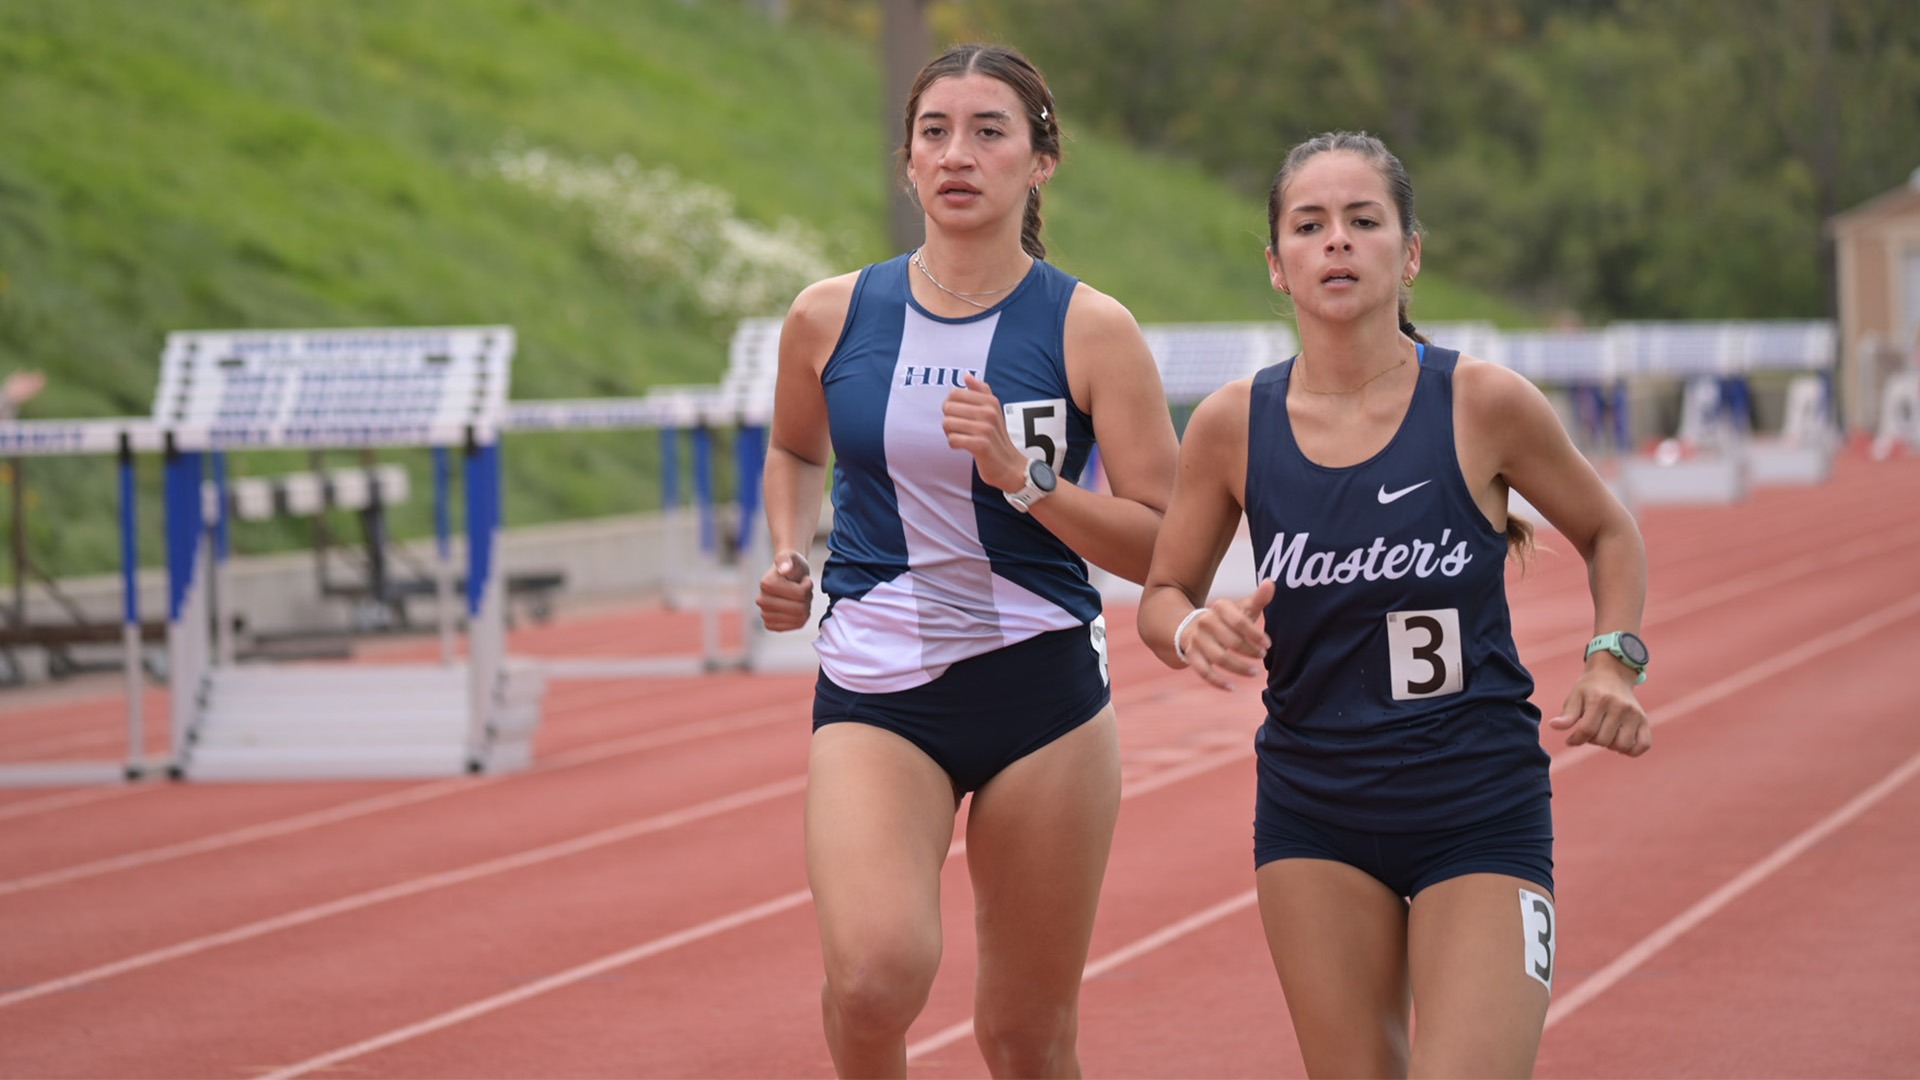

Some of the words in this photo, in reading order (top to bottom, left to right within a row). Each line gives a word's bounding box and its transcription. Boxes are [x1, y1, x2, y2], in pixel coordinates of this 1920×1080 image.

[903, 366, 976, 388] HIU
[1022, 406, 1056, 468] 5
[1257, 528, 1473, 589] Master's
[1404, 615, 1447, 695] 3
[1532, 899, 1551, 982] 3
